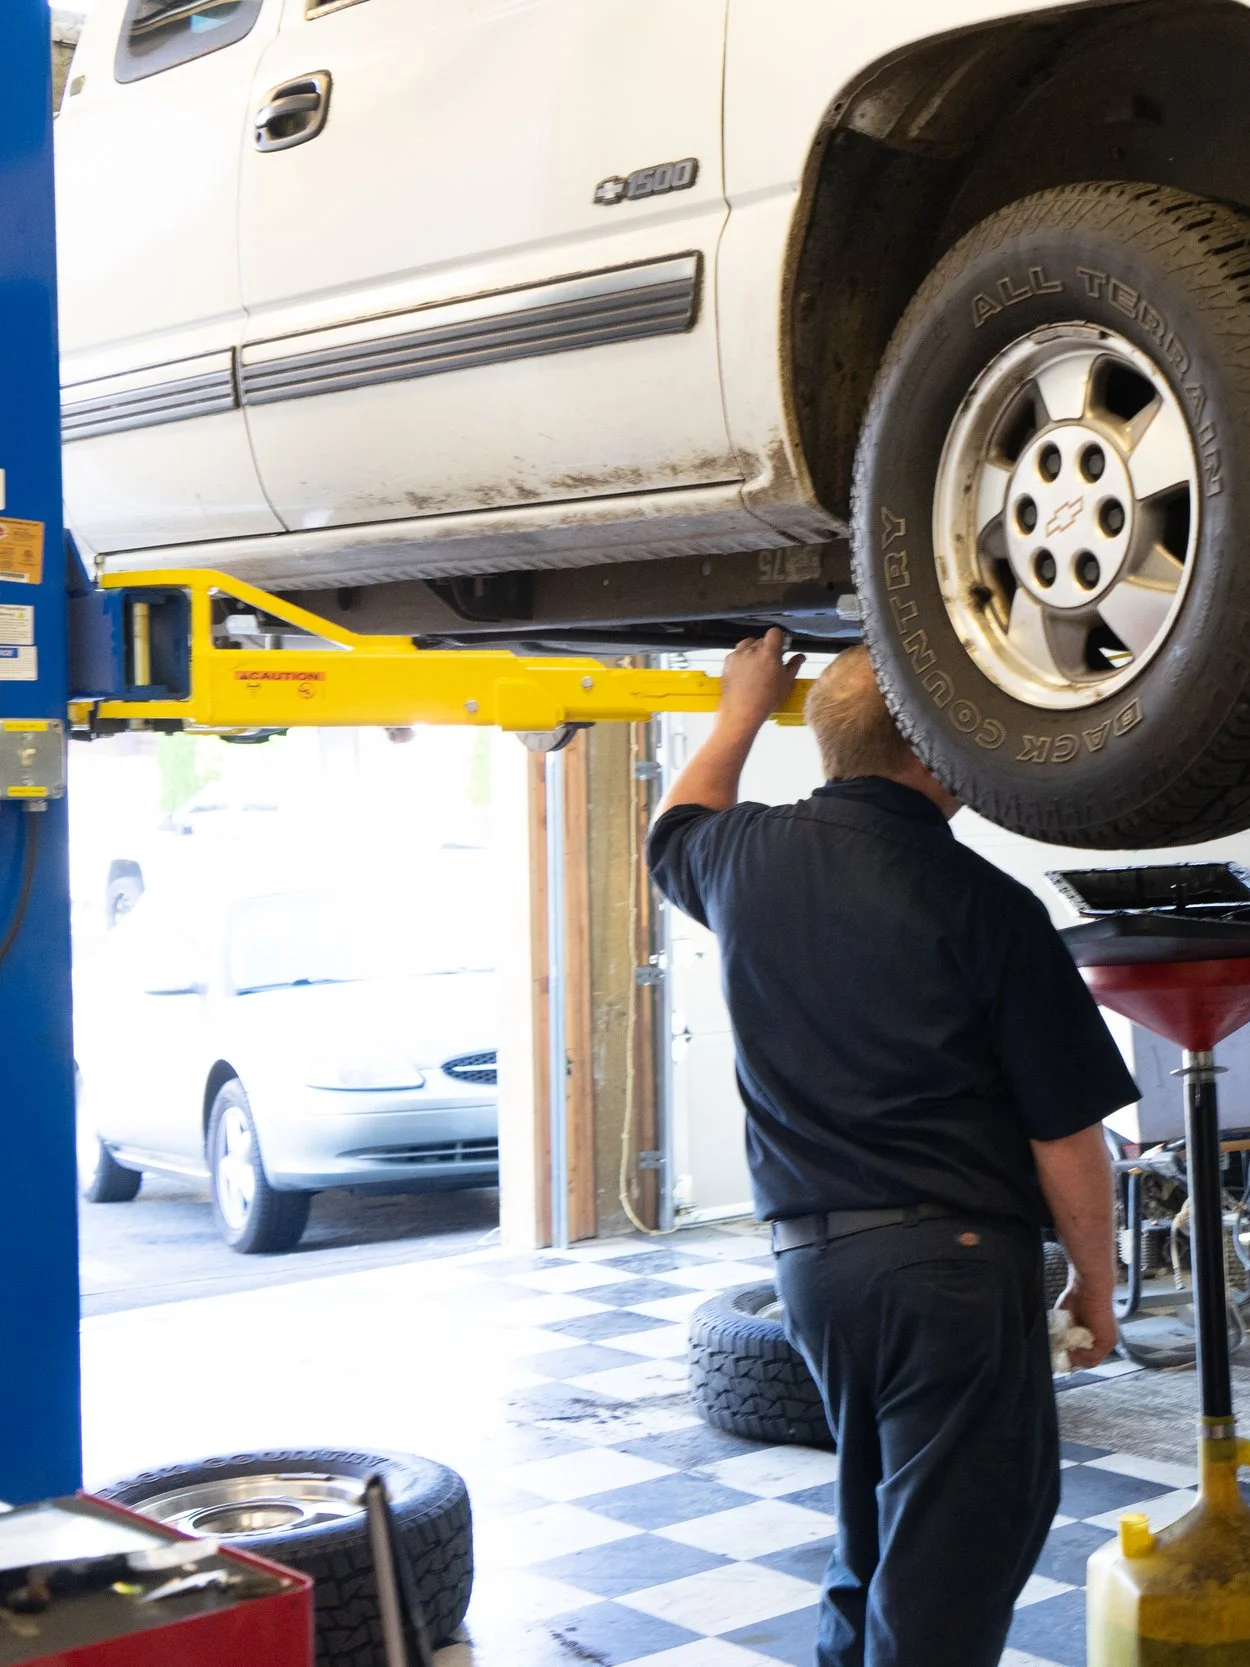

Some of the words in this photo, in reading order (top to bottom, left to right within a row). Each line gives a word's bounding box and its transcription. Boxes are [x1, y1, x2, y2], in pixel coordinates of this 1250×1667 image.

[627, 159, 698, 199] 1500
[968, 265, 1065, 329] ALL
[1075, 264, 1224, 499] TERRAIN
[880, 505, 1008, 750] COUNTRY
[249, 672, 319, 680] CAUTION
[1015, 696, 1145, 765] BACK
